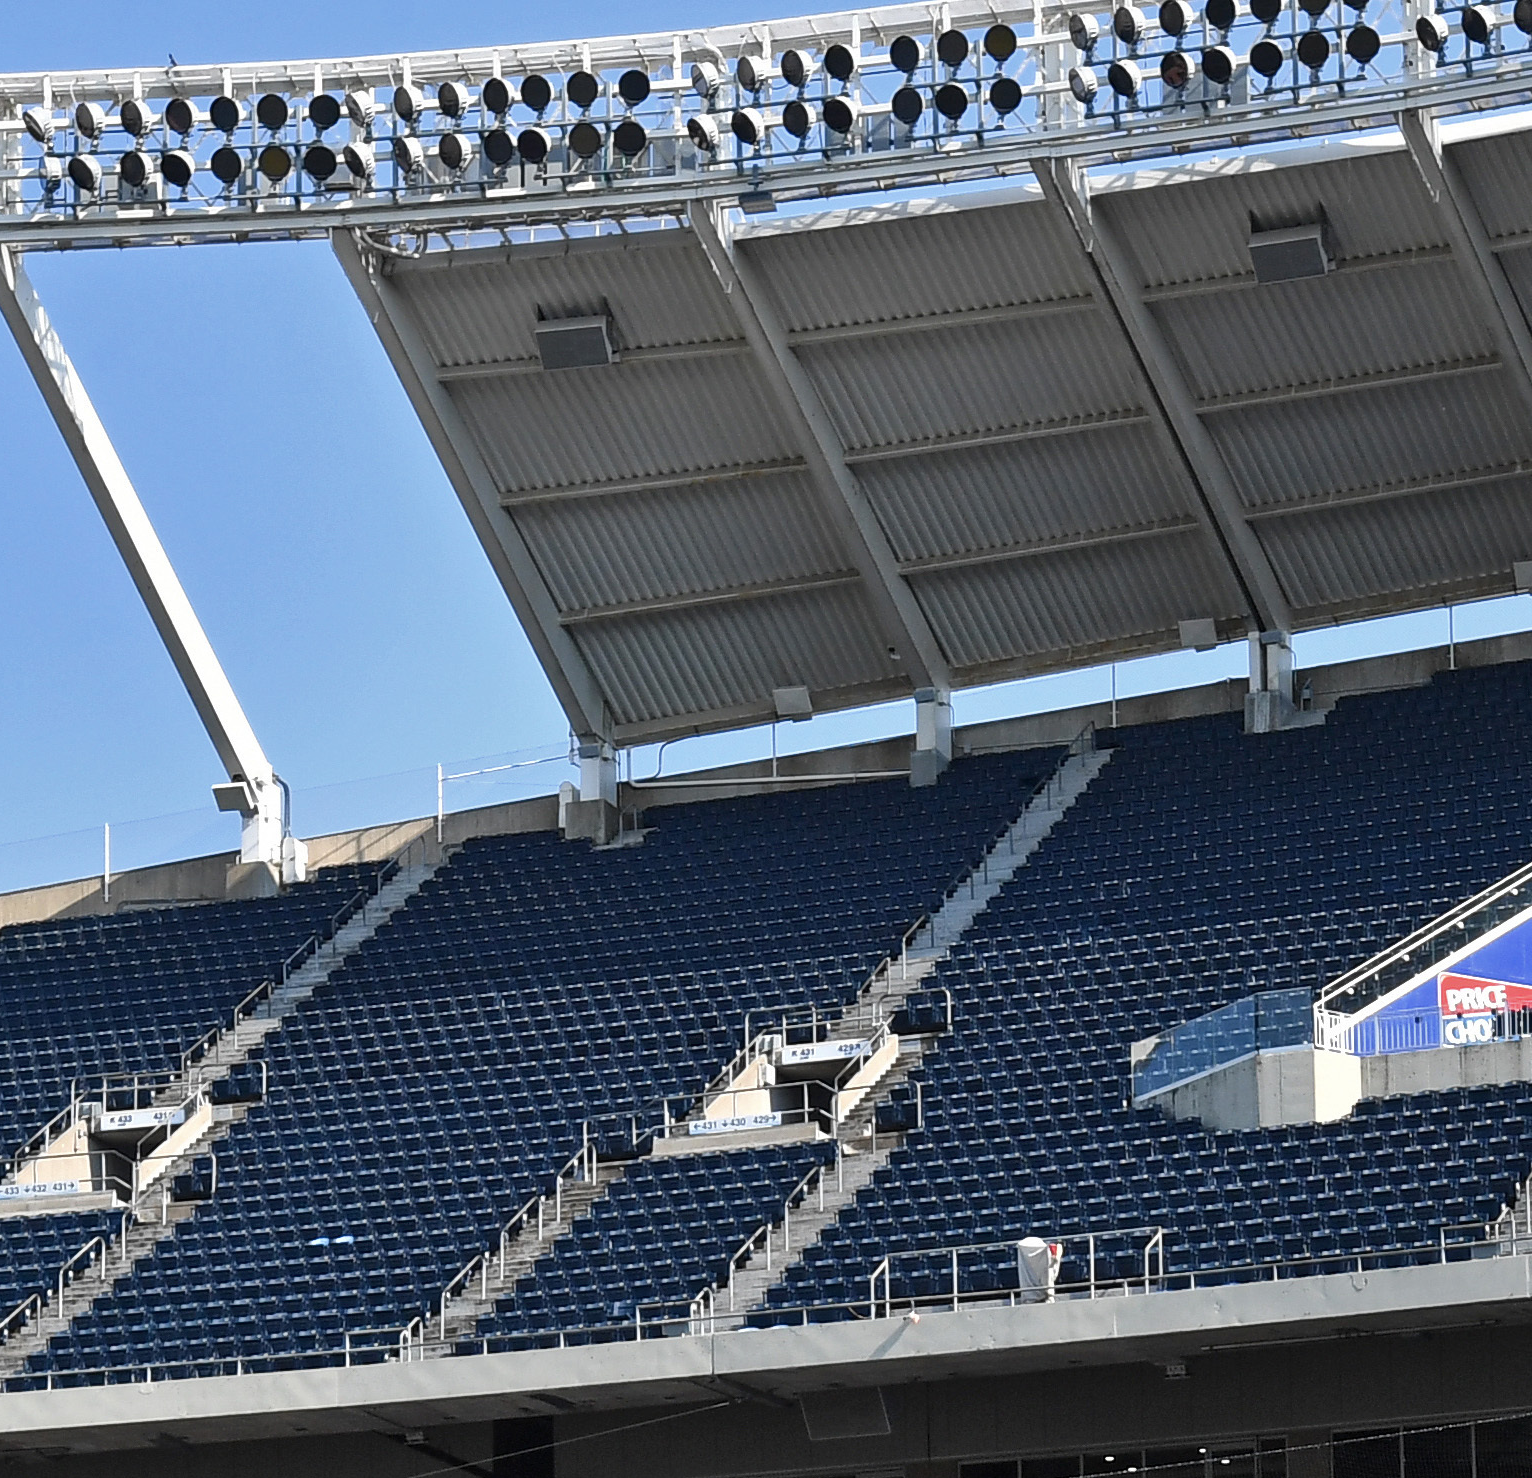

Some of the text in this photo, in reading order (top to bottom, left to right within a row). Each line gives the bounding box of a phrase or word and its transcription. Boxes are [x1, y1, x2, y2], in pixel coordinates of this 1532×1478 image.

[1446, 985, 1506, 1011] PRICE
[1445, 1018, 1492, 1044] CHO
[799, 1048, 815, 1056] 431
[701, 1115, 769, 1130] 431 430 429
[4, 1182, 67, 1195] 433 432 431
